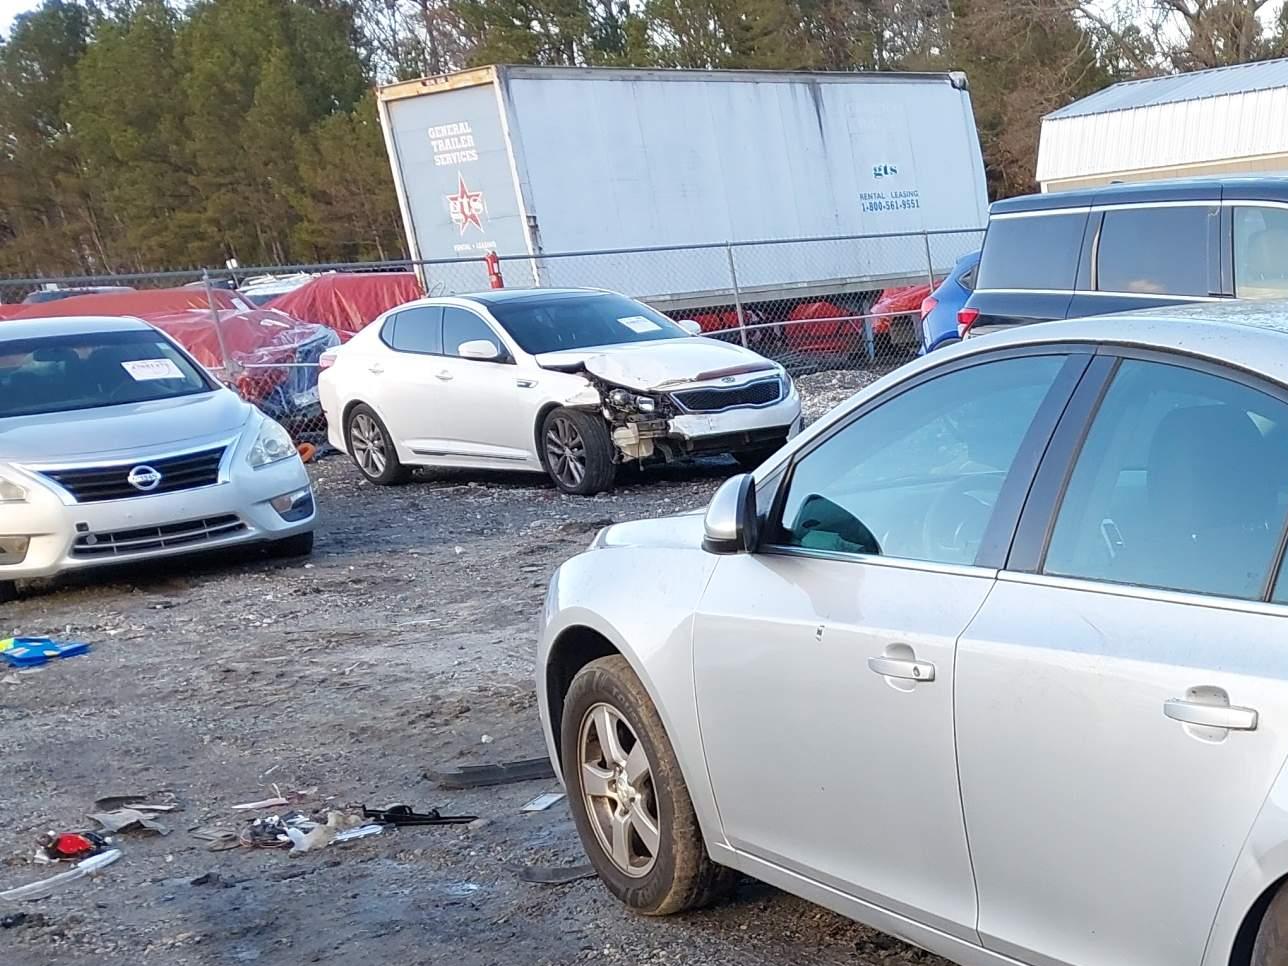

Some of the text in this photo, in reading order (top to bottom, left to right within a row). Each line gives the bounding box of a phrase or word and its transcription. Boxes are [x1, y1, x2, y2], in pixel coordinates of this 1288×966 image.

[428, 121, 472, 139] GENERAL
[431, 135, 475, 153] TRAILER
[434, 149, 478, 166] SERVICES
[873, 164, 897, 179] gts
[859, 190, 919, 201] RENTAL LEASING
